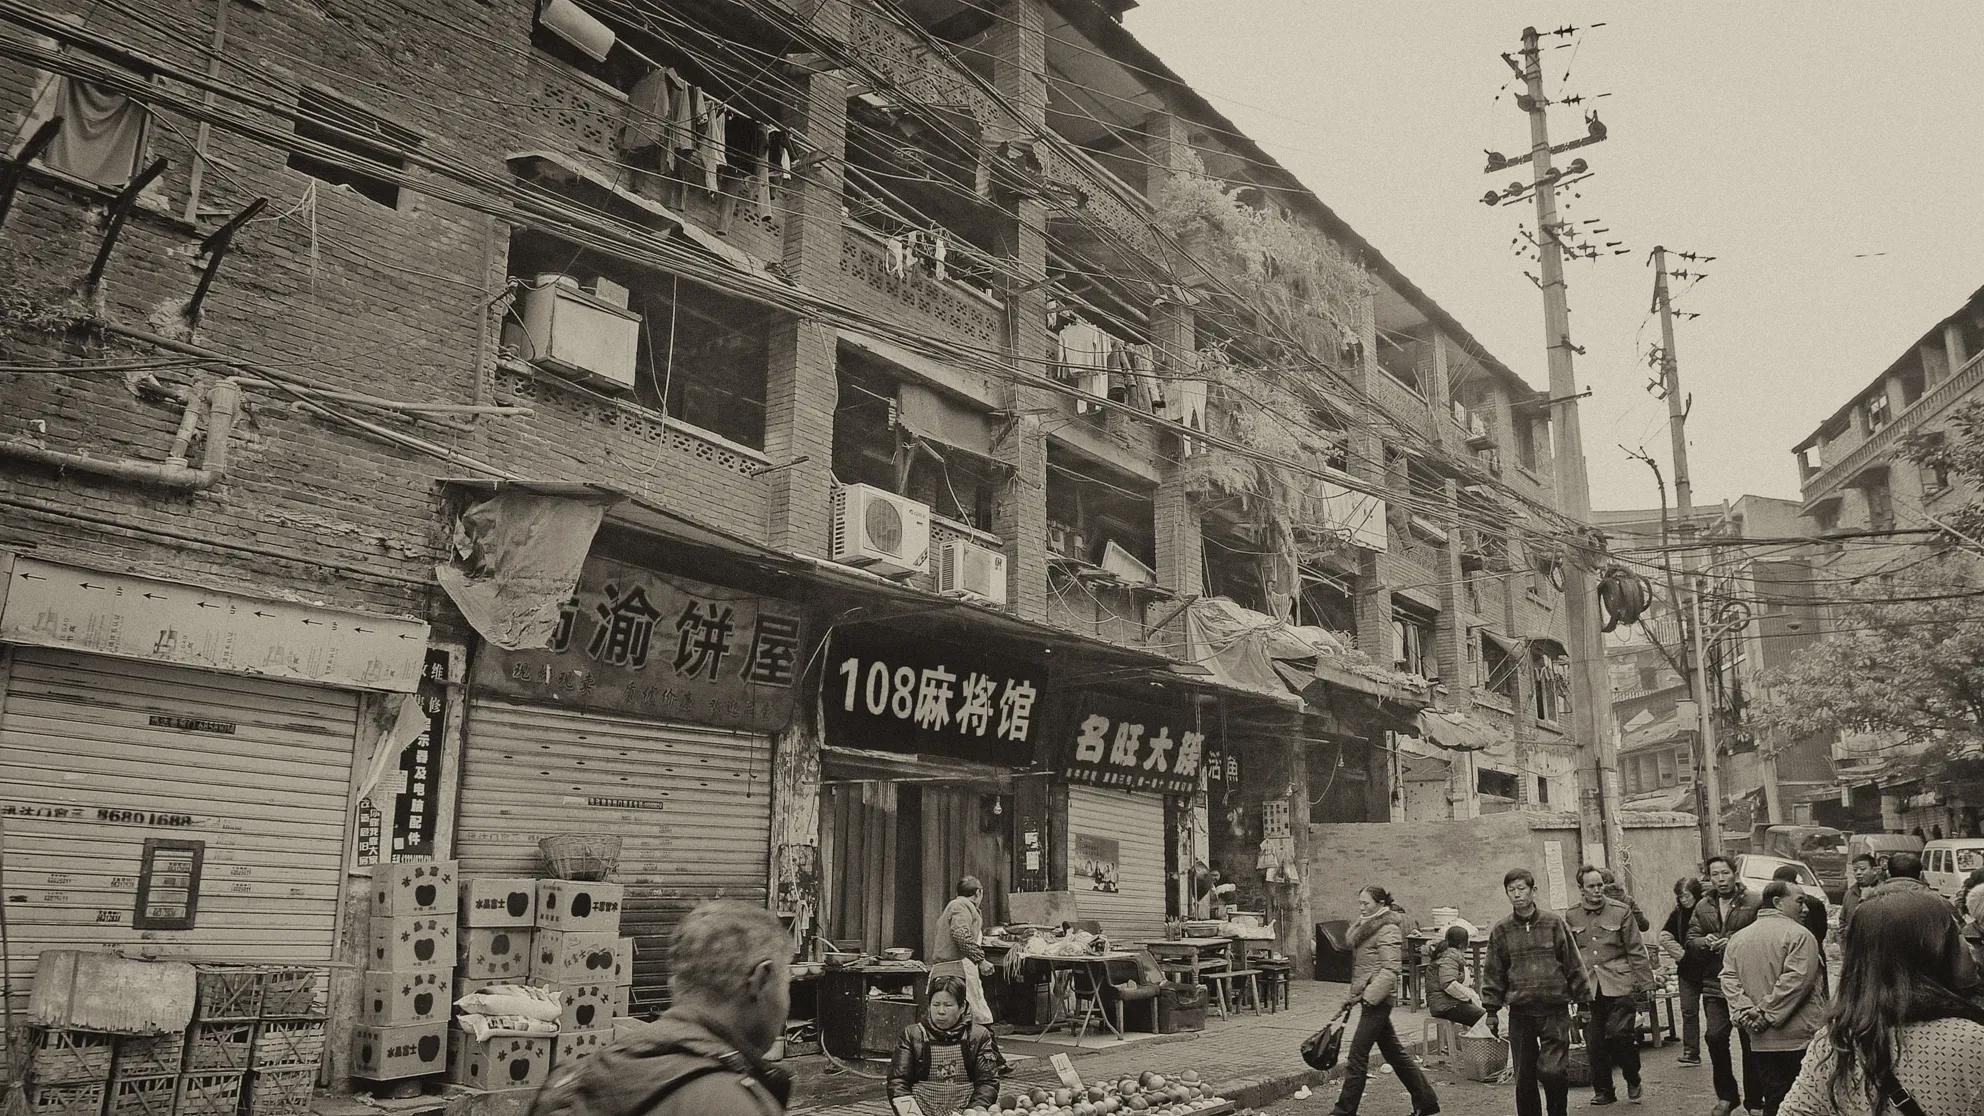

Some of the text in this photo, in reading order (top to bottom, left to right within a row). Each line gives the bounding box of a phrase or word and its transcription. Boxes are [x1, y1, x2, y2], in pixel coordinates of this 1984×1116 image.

[840, 657, 1036, 742] 108麻将馆
[475, 898, 505, 910] 水晶富士
